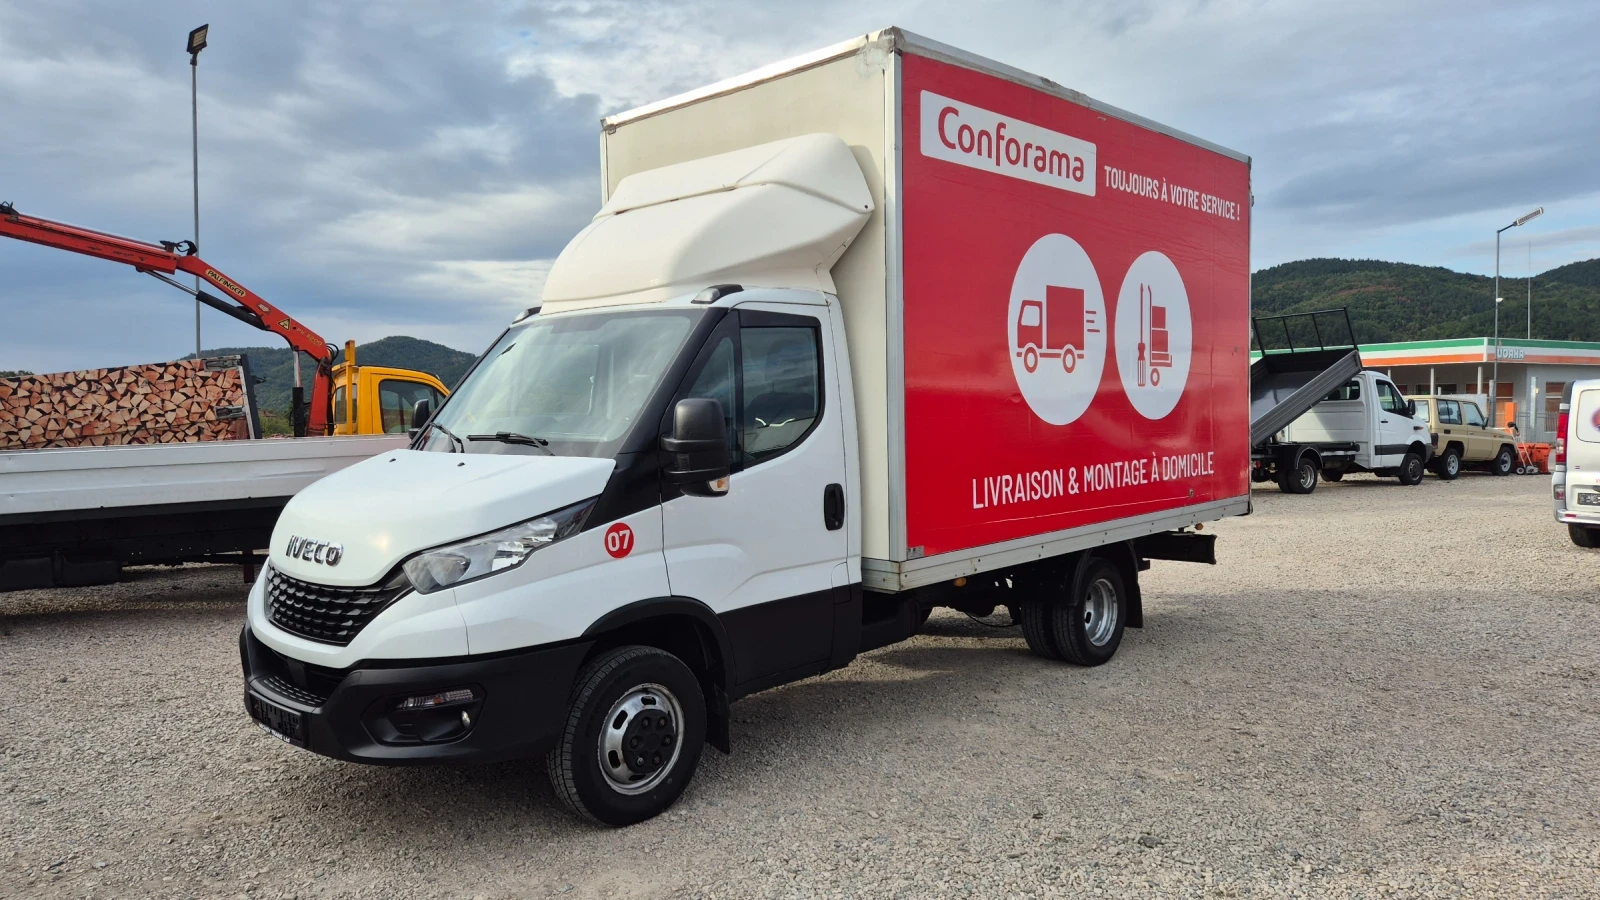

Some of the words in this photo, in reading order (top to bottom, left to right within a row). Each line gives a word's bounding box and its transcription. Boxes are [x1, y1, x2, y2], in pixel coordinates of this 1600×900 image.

[938, 106, 1084, 182] Conforama
[1104, 165, 1159, 200] TOUJOURS
[1161, 177, 1168, 203] À
[1170, 184, 1199, 210] VOTRE
[1201, 193, 1236, 220] SERVICE
[1237, 204, 1240, 221] !
[207, 270, 245, 296] PALFINGER
[972, 468, 1064, 509] LIVRAISON
[1067, 466, 1080, 495] &
[1083, 458, 1149, 492] MONTAGE
[1151, 451, 1160, 483] À
[1162, 451, 1214, 480] DOMICILE
[285, 534, 344, 567] IVECO
[607, 529, 631, 552] 07
